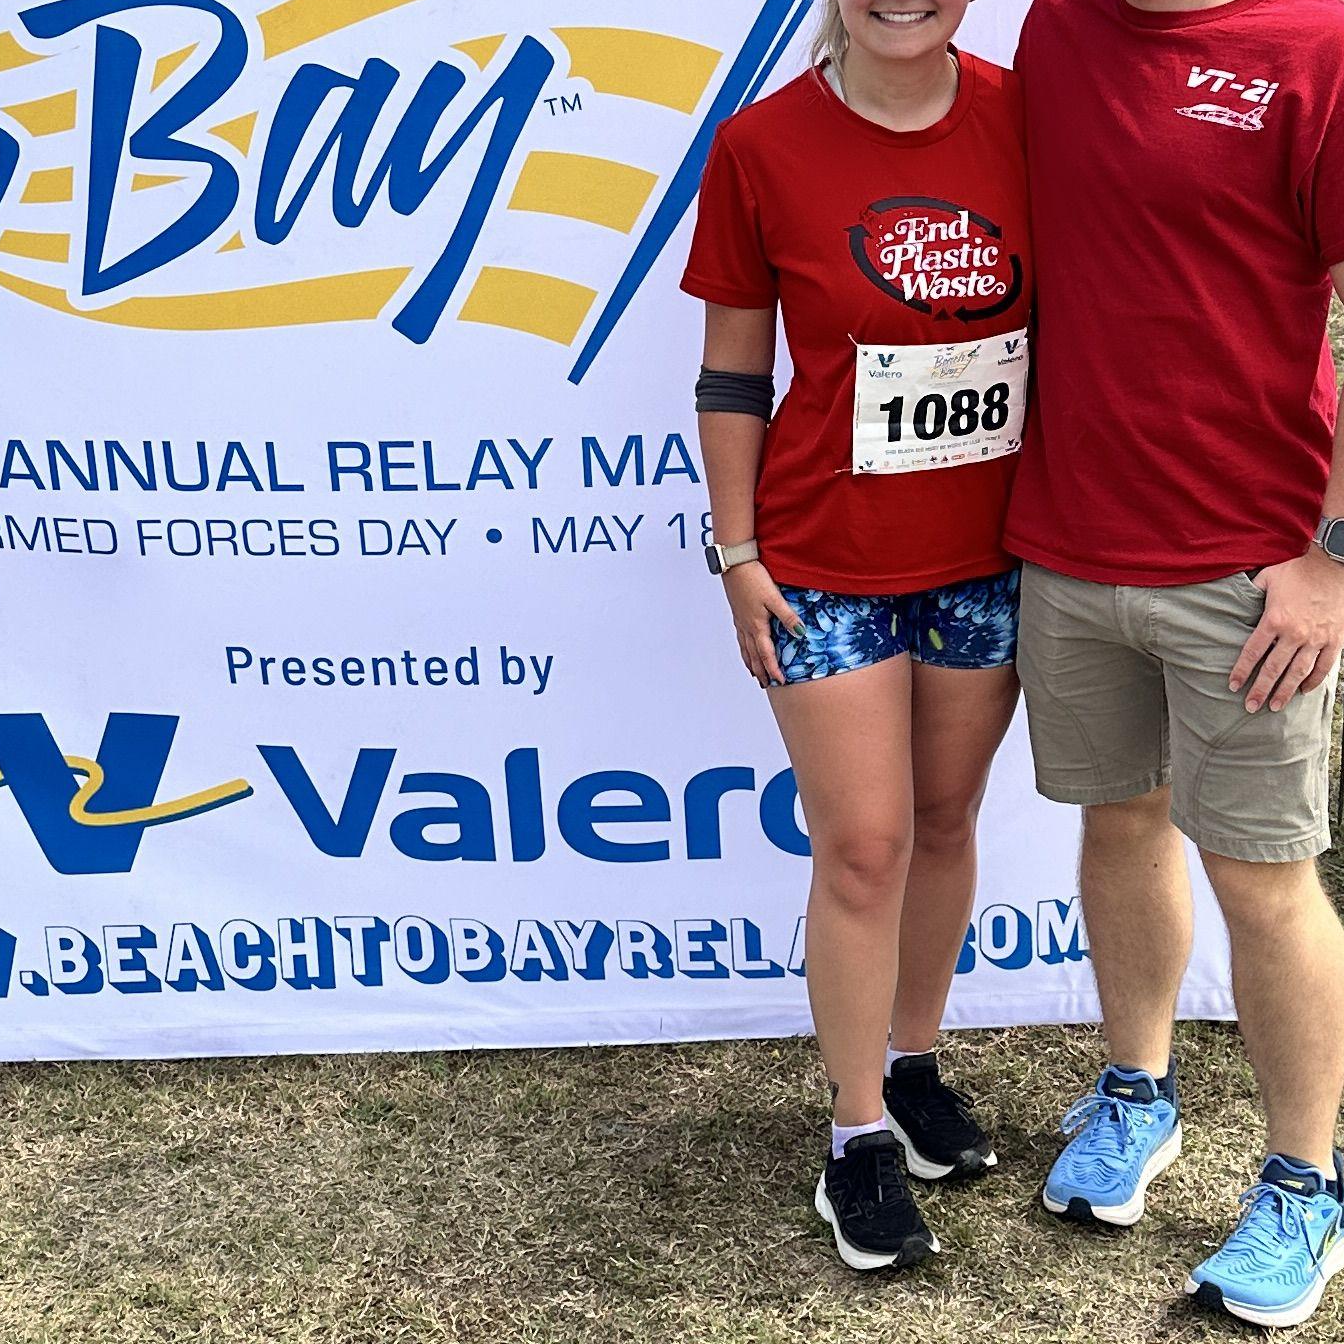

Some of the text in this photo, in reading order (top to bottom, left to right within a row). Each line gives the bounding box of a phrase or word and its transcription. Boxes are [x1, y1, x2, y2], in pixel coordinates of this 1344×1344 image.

[1186, 65, 1280, 105] VT-21
[894, 210, 970, 245] End
[879, 237, 999, 281] Plastic
[898, 270, 1007, 302] Waste
[868, 369, 903, 379] Valero
[879, 381, 1010, 443] 1088
[0, 439, 305, 492] ANNUAL
[328, 437, 554, 492] RELAY
[137, 519, 340, 556] FORCES
[359, 518, 457, 556] DAY
[532, 515, 644, 554] MAY
[226, 645, 554, 695] Presented by
